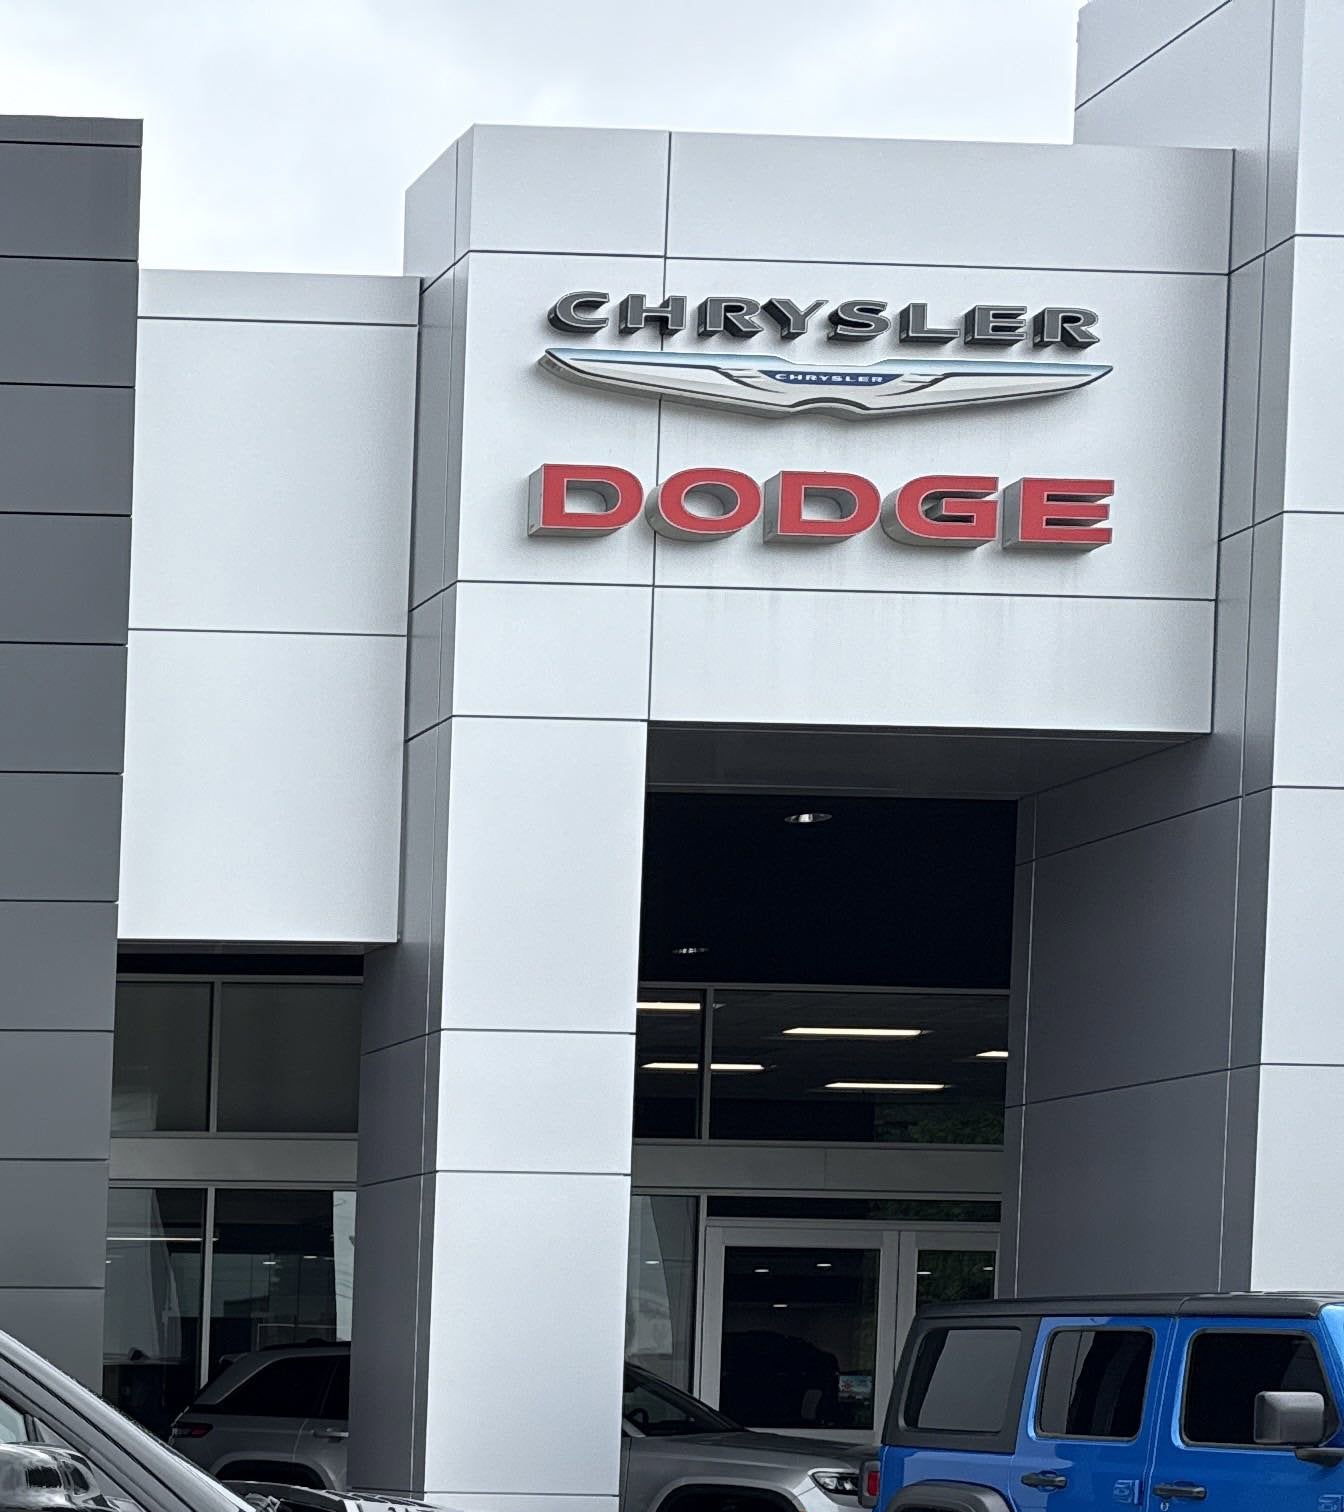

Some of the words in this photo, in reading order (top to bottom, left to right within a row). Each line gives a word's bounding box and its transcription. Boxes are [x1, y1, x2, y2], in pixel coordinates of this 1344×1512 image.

[548, 291, 1100, 348] CHRYSLER
[775, 373, 883, 383] CHRYSLER
[527, 464, 1115, 552] DODGE
